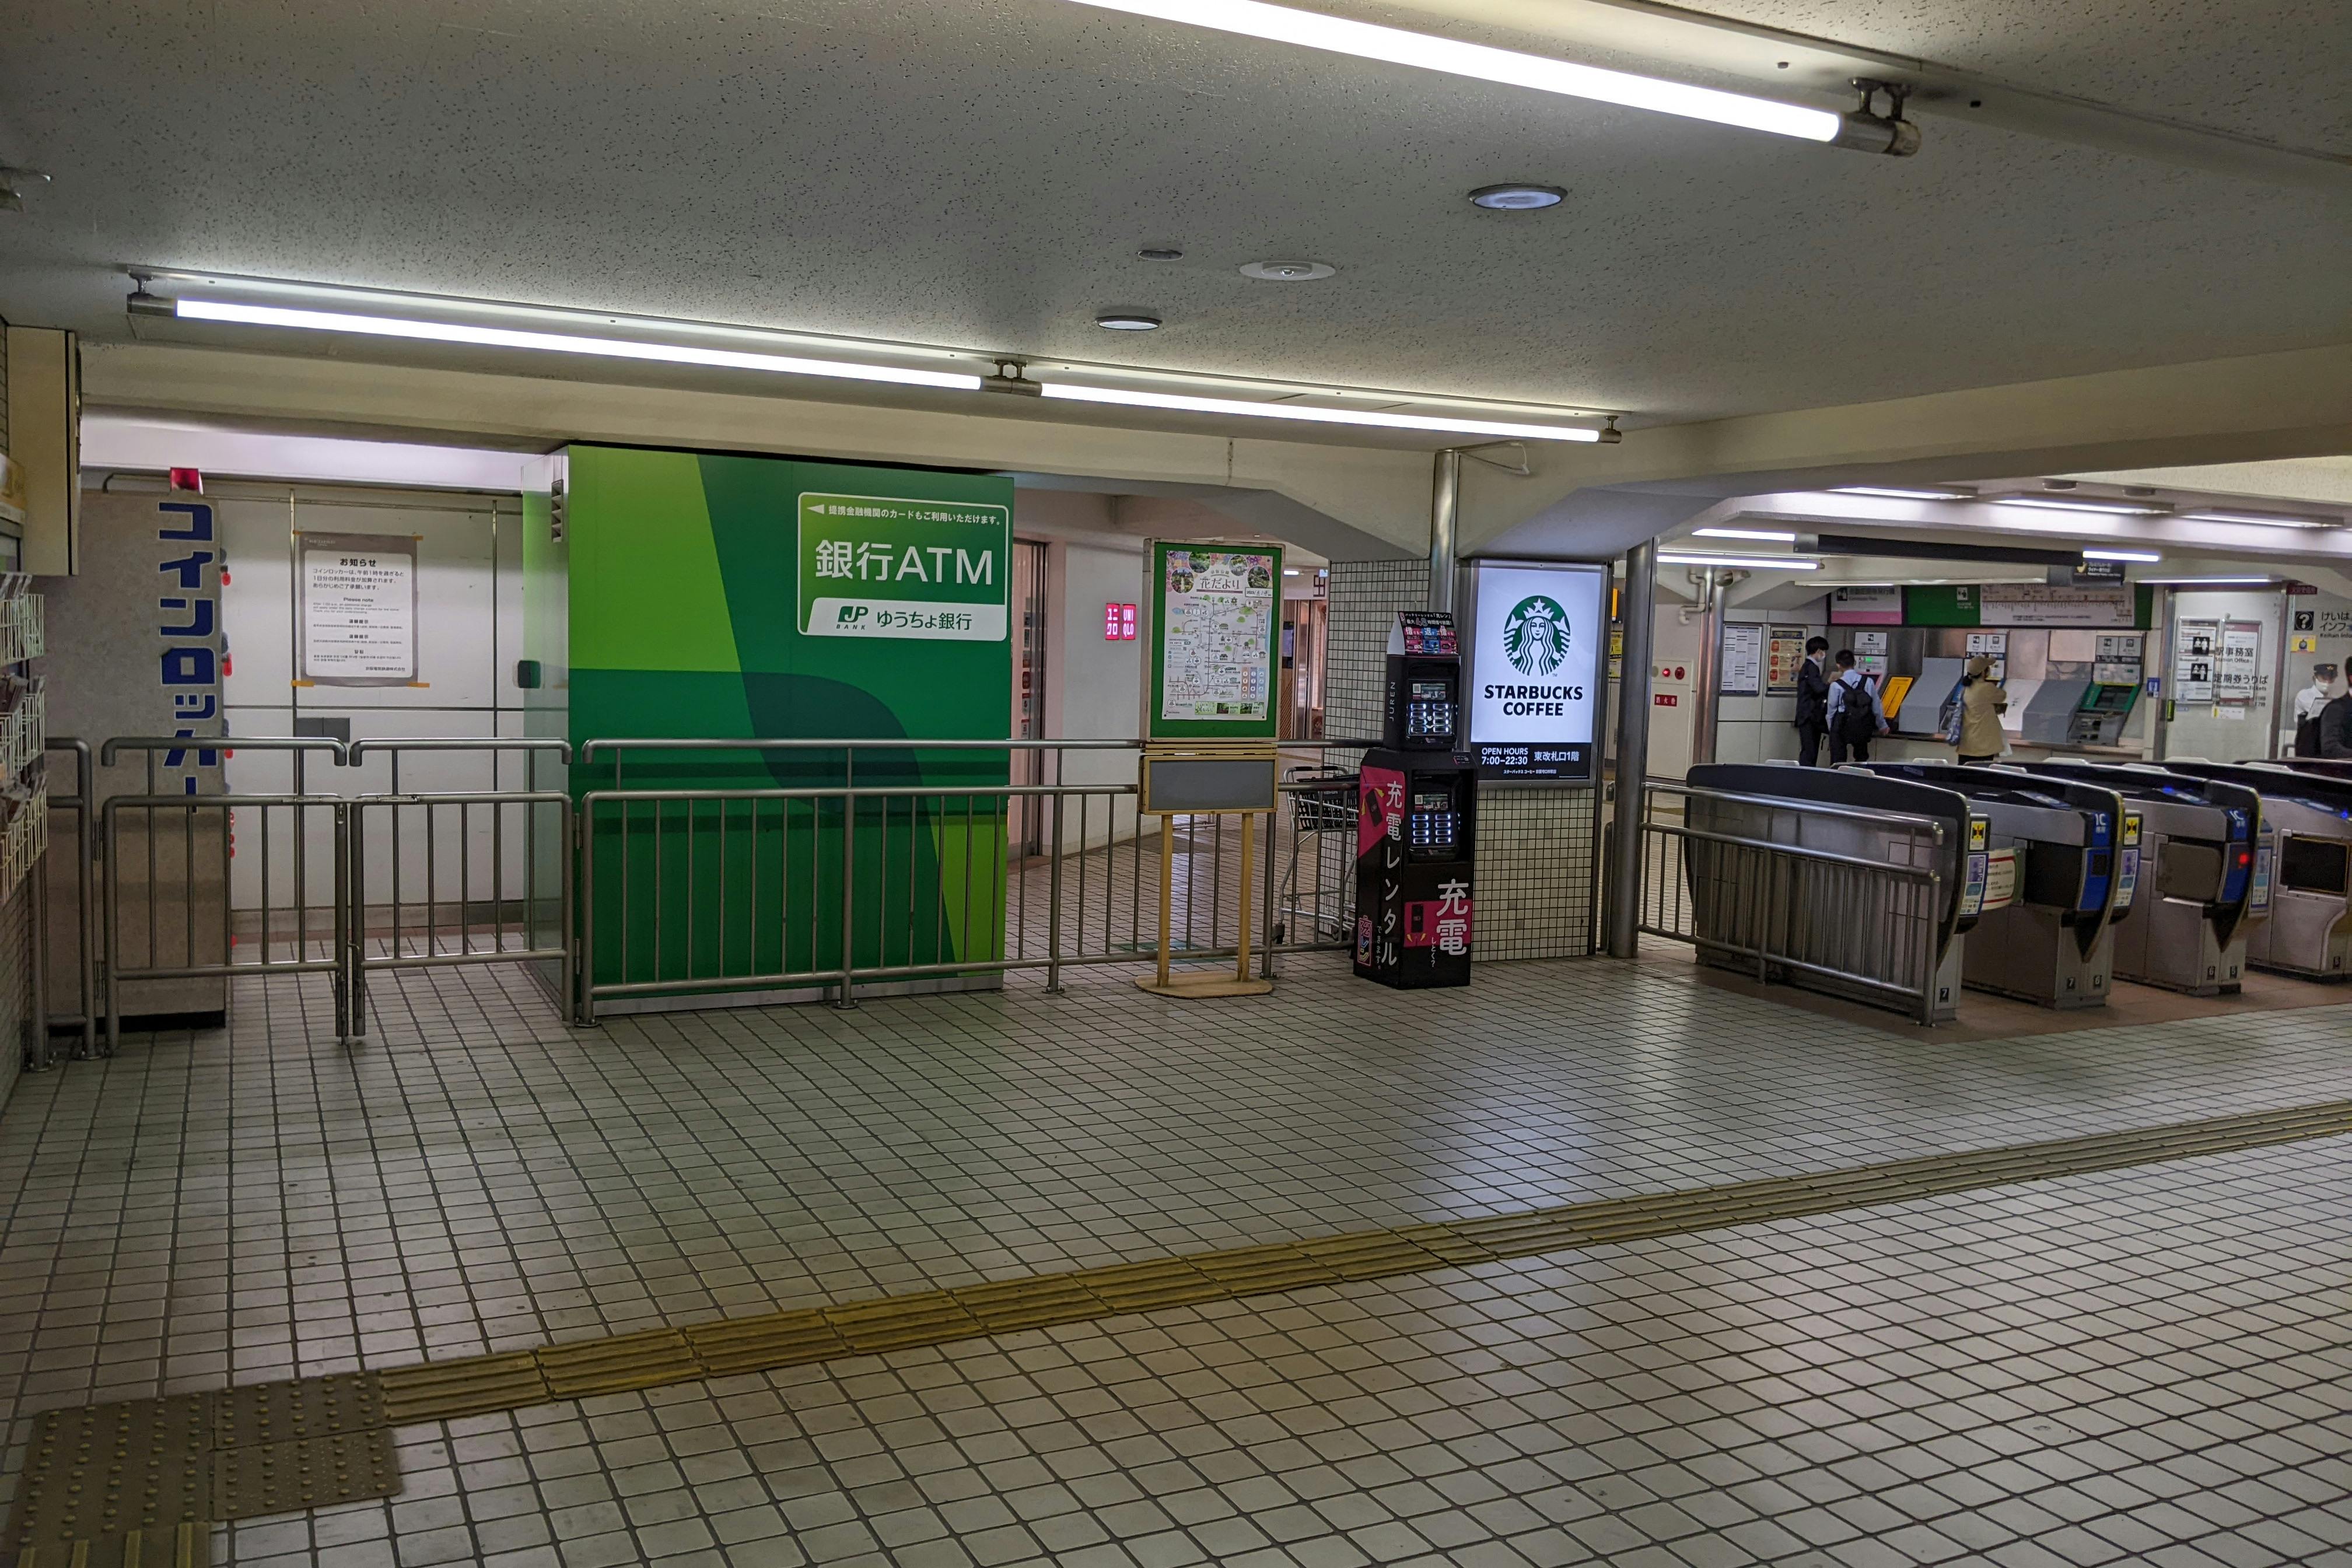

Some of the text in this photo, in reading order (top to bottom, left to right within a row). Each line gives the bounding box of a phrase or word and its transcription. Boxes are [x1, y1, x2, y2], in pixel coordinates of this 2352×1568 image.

[828, 505, 1000, 525] 提携金融機関のカードもご利用いただけます。
[340, 558, 377, 567] お知らせ
[815, 539, 993, 585] 銀行ATM
[1200, 577, 1240, 590] 花だより
[838, 606, 869, 623] JP
[876, 609, 972, 631] ゆうちょ銀行
[1123, 609, 1133, 621] UNI
[1123, 623, 1134, 637] QLO
[159, 502, 218, 814] コインロッカー
[2213, 673, 2269, 684] 定期券うりば
[1483, 684, 1584, 701] STARBUCKS
[1503, 701, 1564, 717] COFFEE
[1482, 747, 1528, 755] OPEN HOURS
[1534, 751, 1580, 762] 東改札口1階
[2095, 813, 2106, 826] IC
[1382, 780, 1403, 967] 充電レンタル
[1436, 878, 1470, 956] 充電
